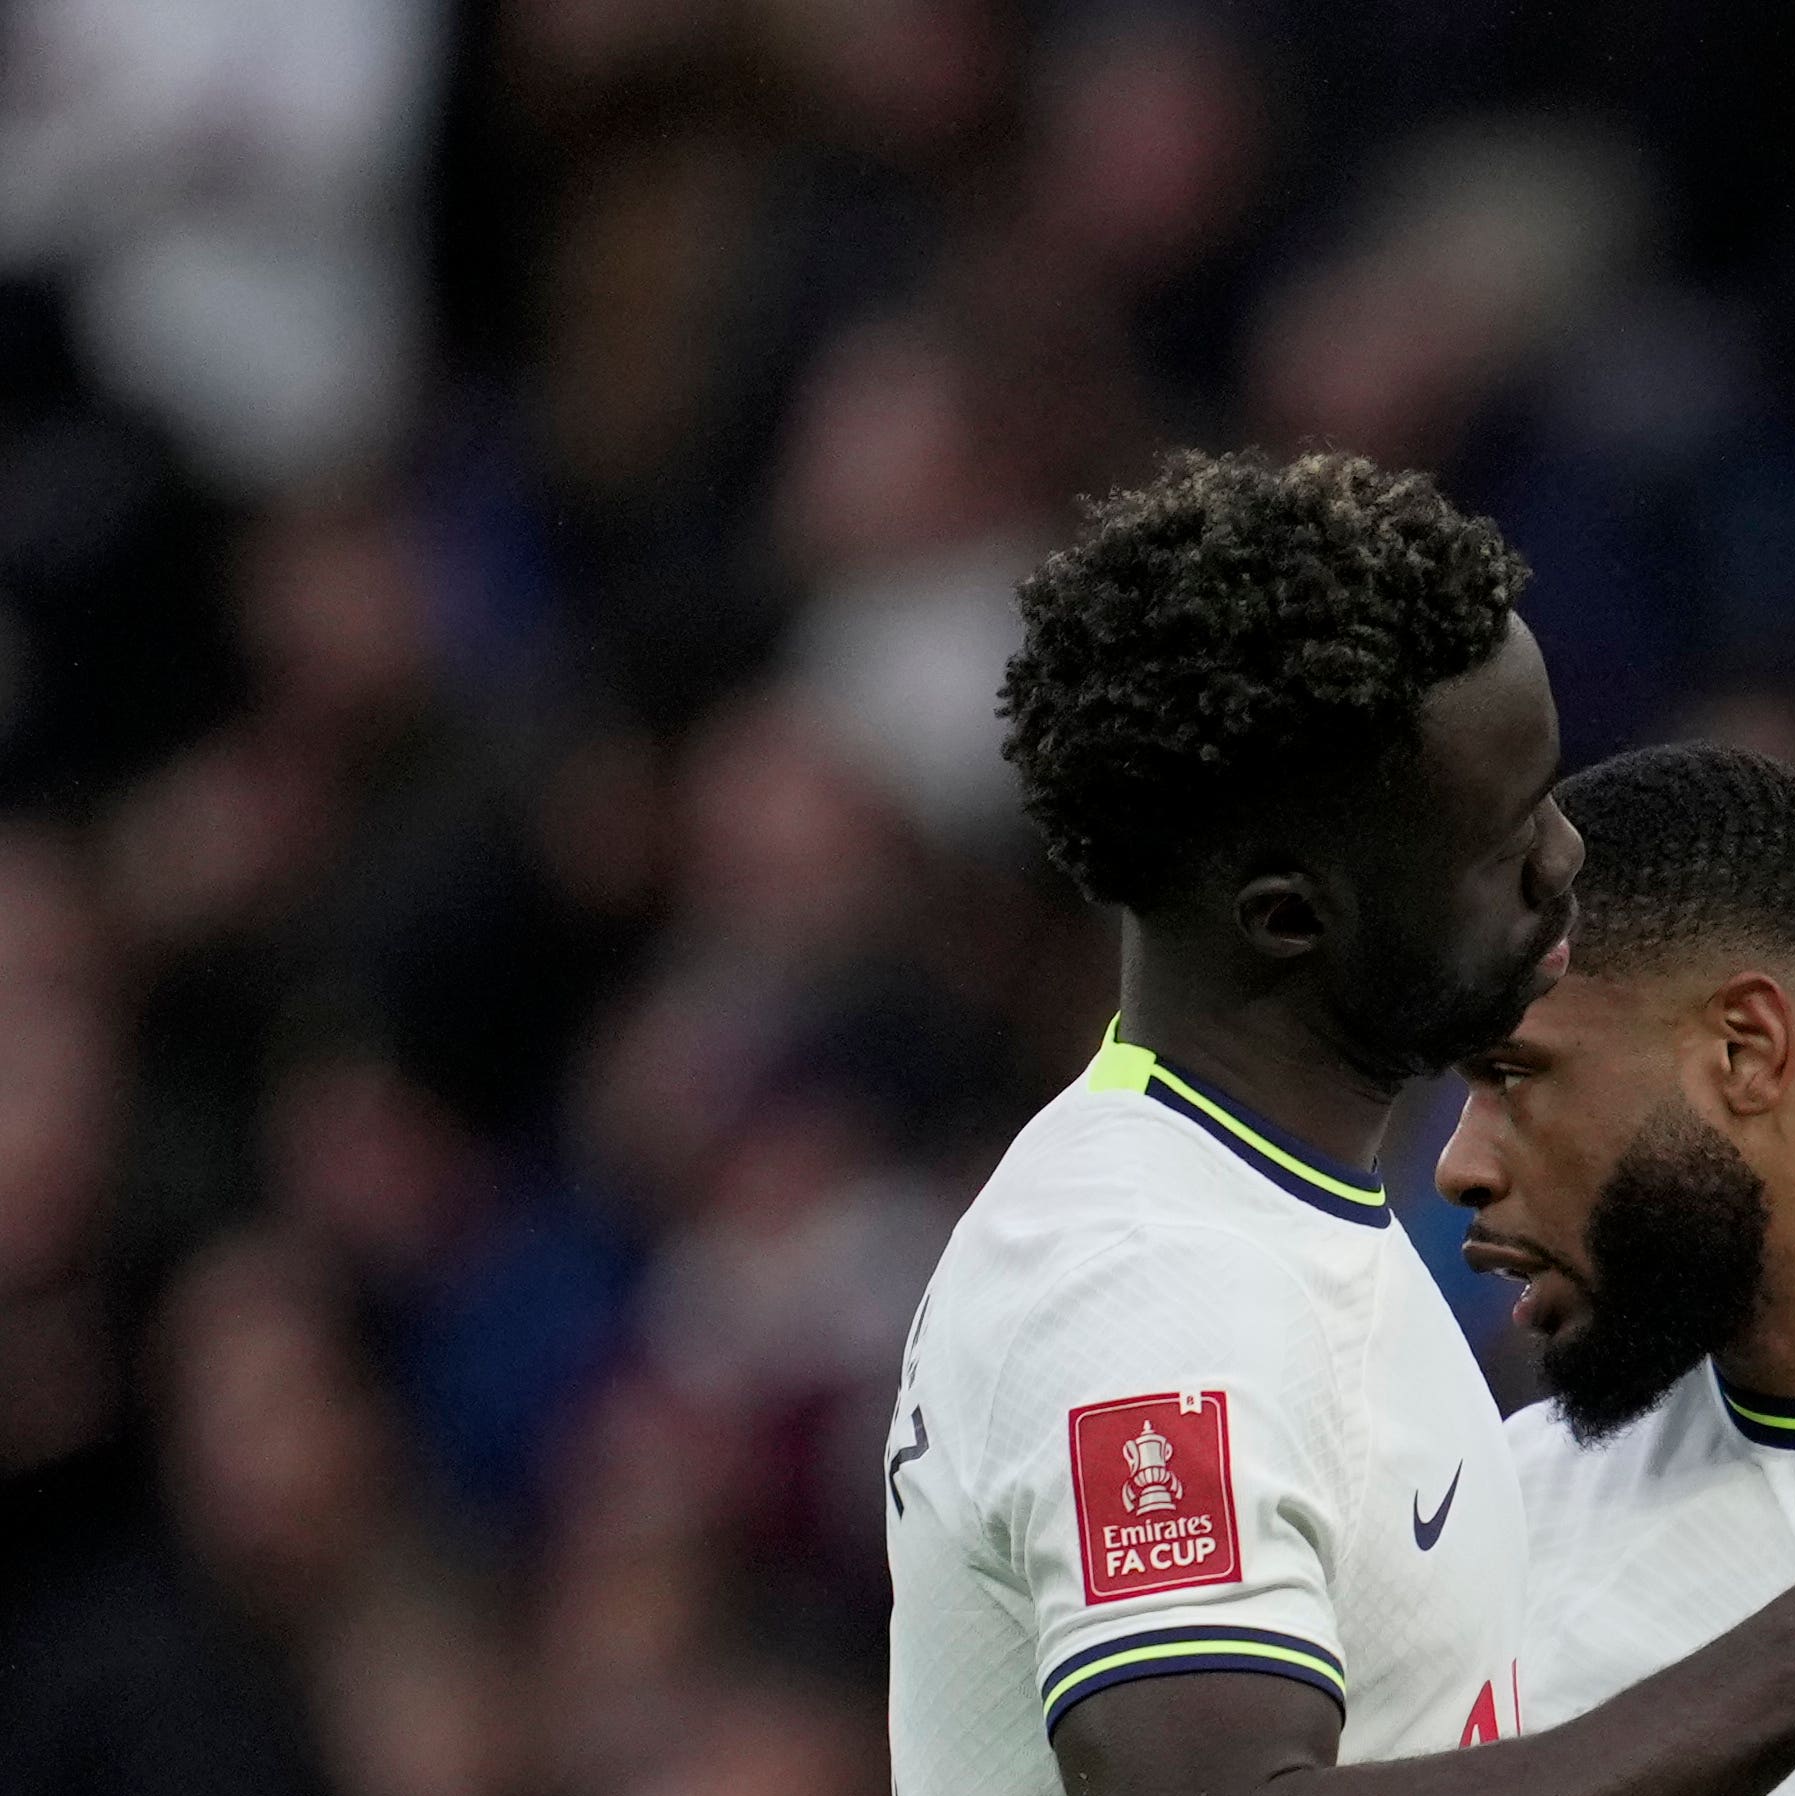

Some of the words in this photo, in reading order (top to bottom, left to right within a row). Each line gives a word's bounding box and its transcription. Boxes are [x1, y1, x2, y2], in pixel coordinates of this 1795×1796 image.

[1102, 1513, 1213, 1549] Emirates
[1106, 1548, 1146, 1577] FA
[1149, 1536, 1217, 1570] CUP
